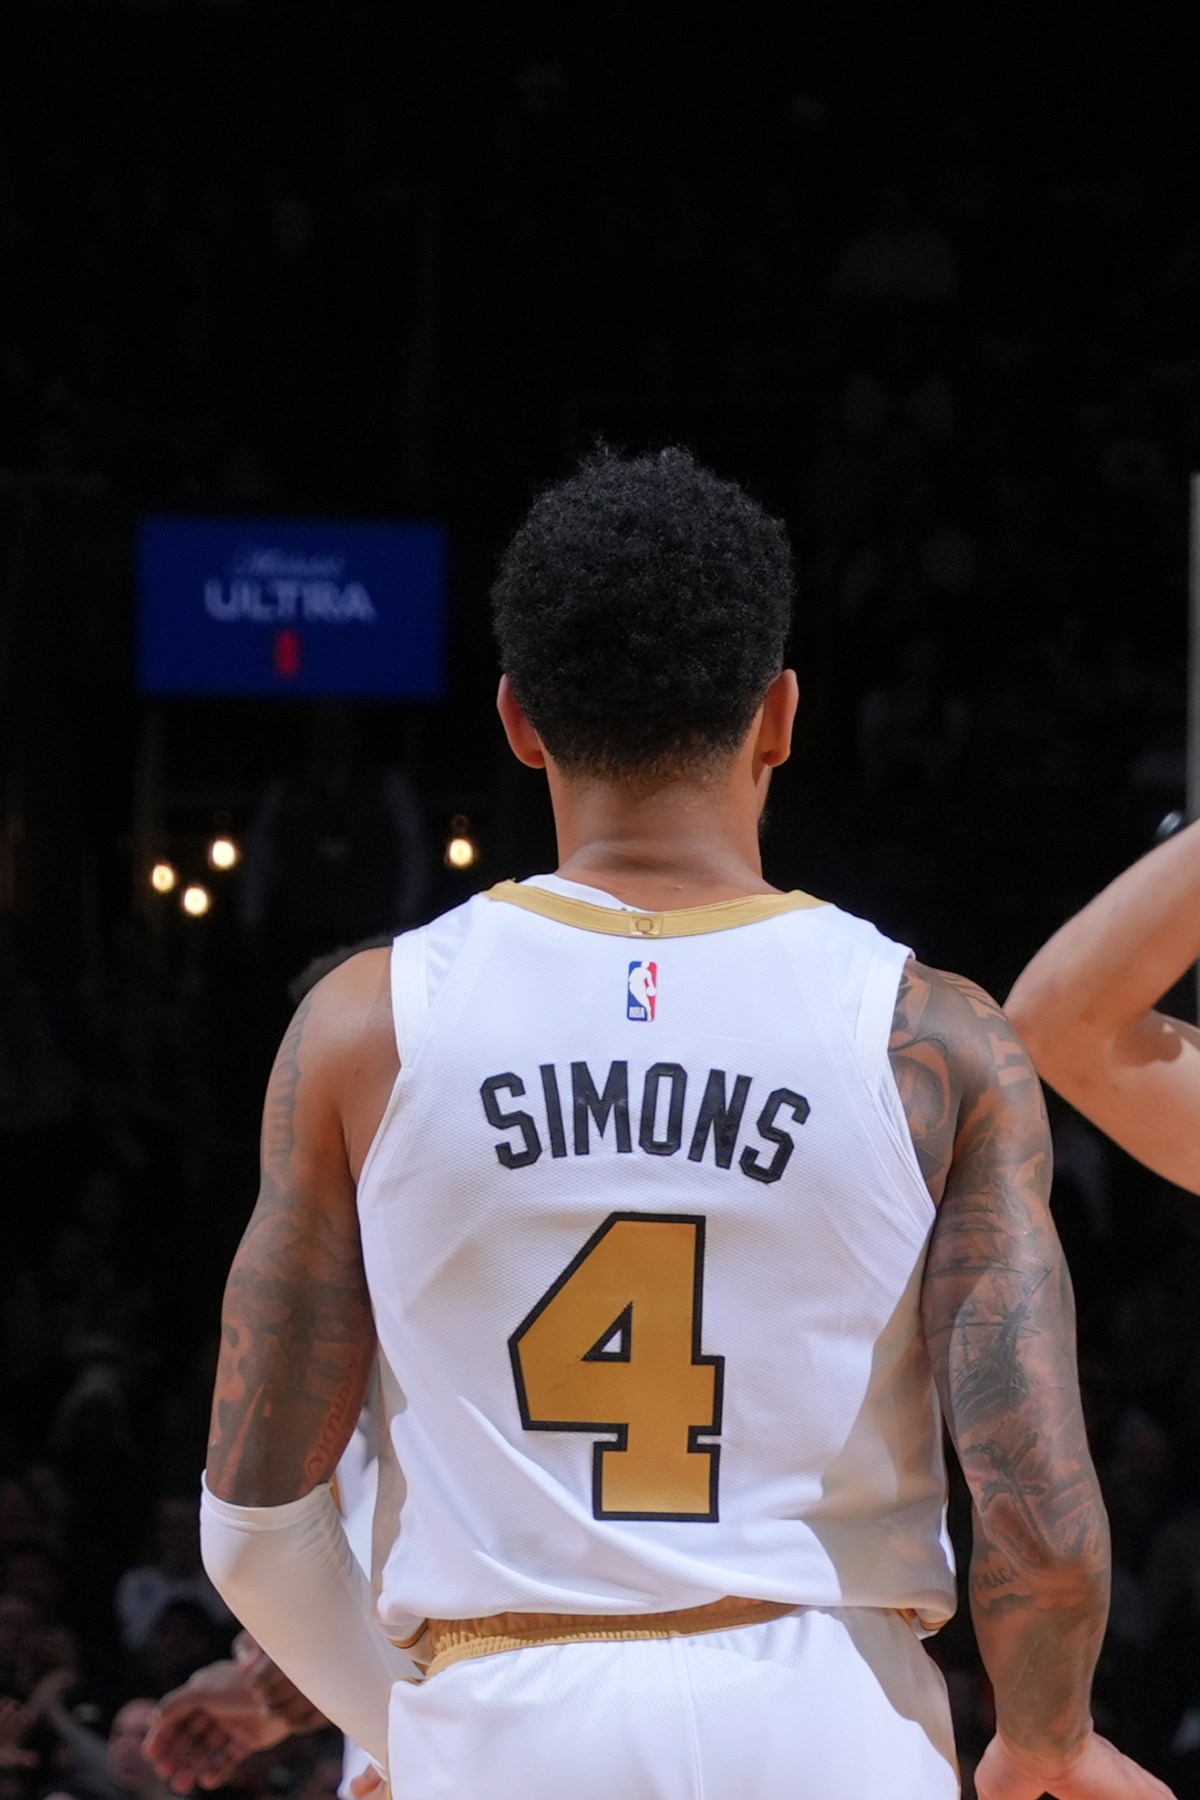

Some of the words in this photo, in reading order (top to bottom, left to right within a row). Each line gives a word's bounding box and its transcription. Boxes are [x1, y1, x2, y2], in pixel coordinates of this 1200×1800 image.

[204, 577, 378, 624] ULTRA
[479, 1060, 811, 1184] SIMONS
[508, 1210, 725, 1523] 4
